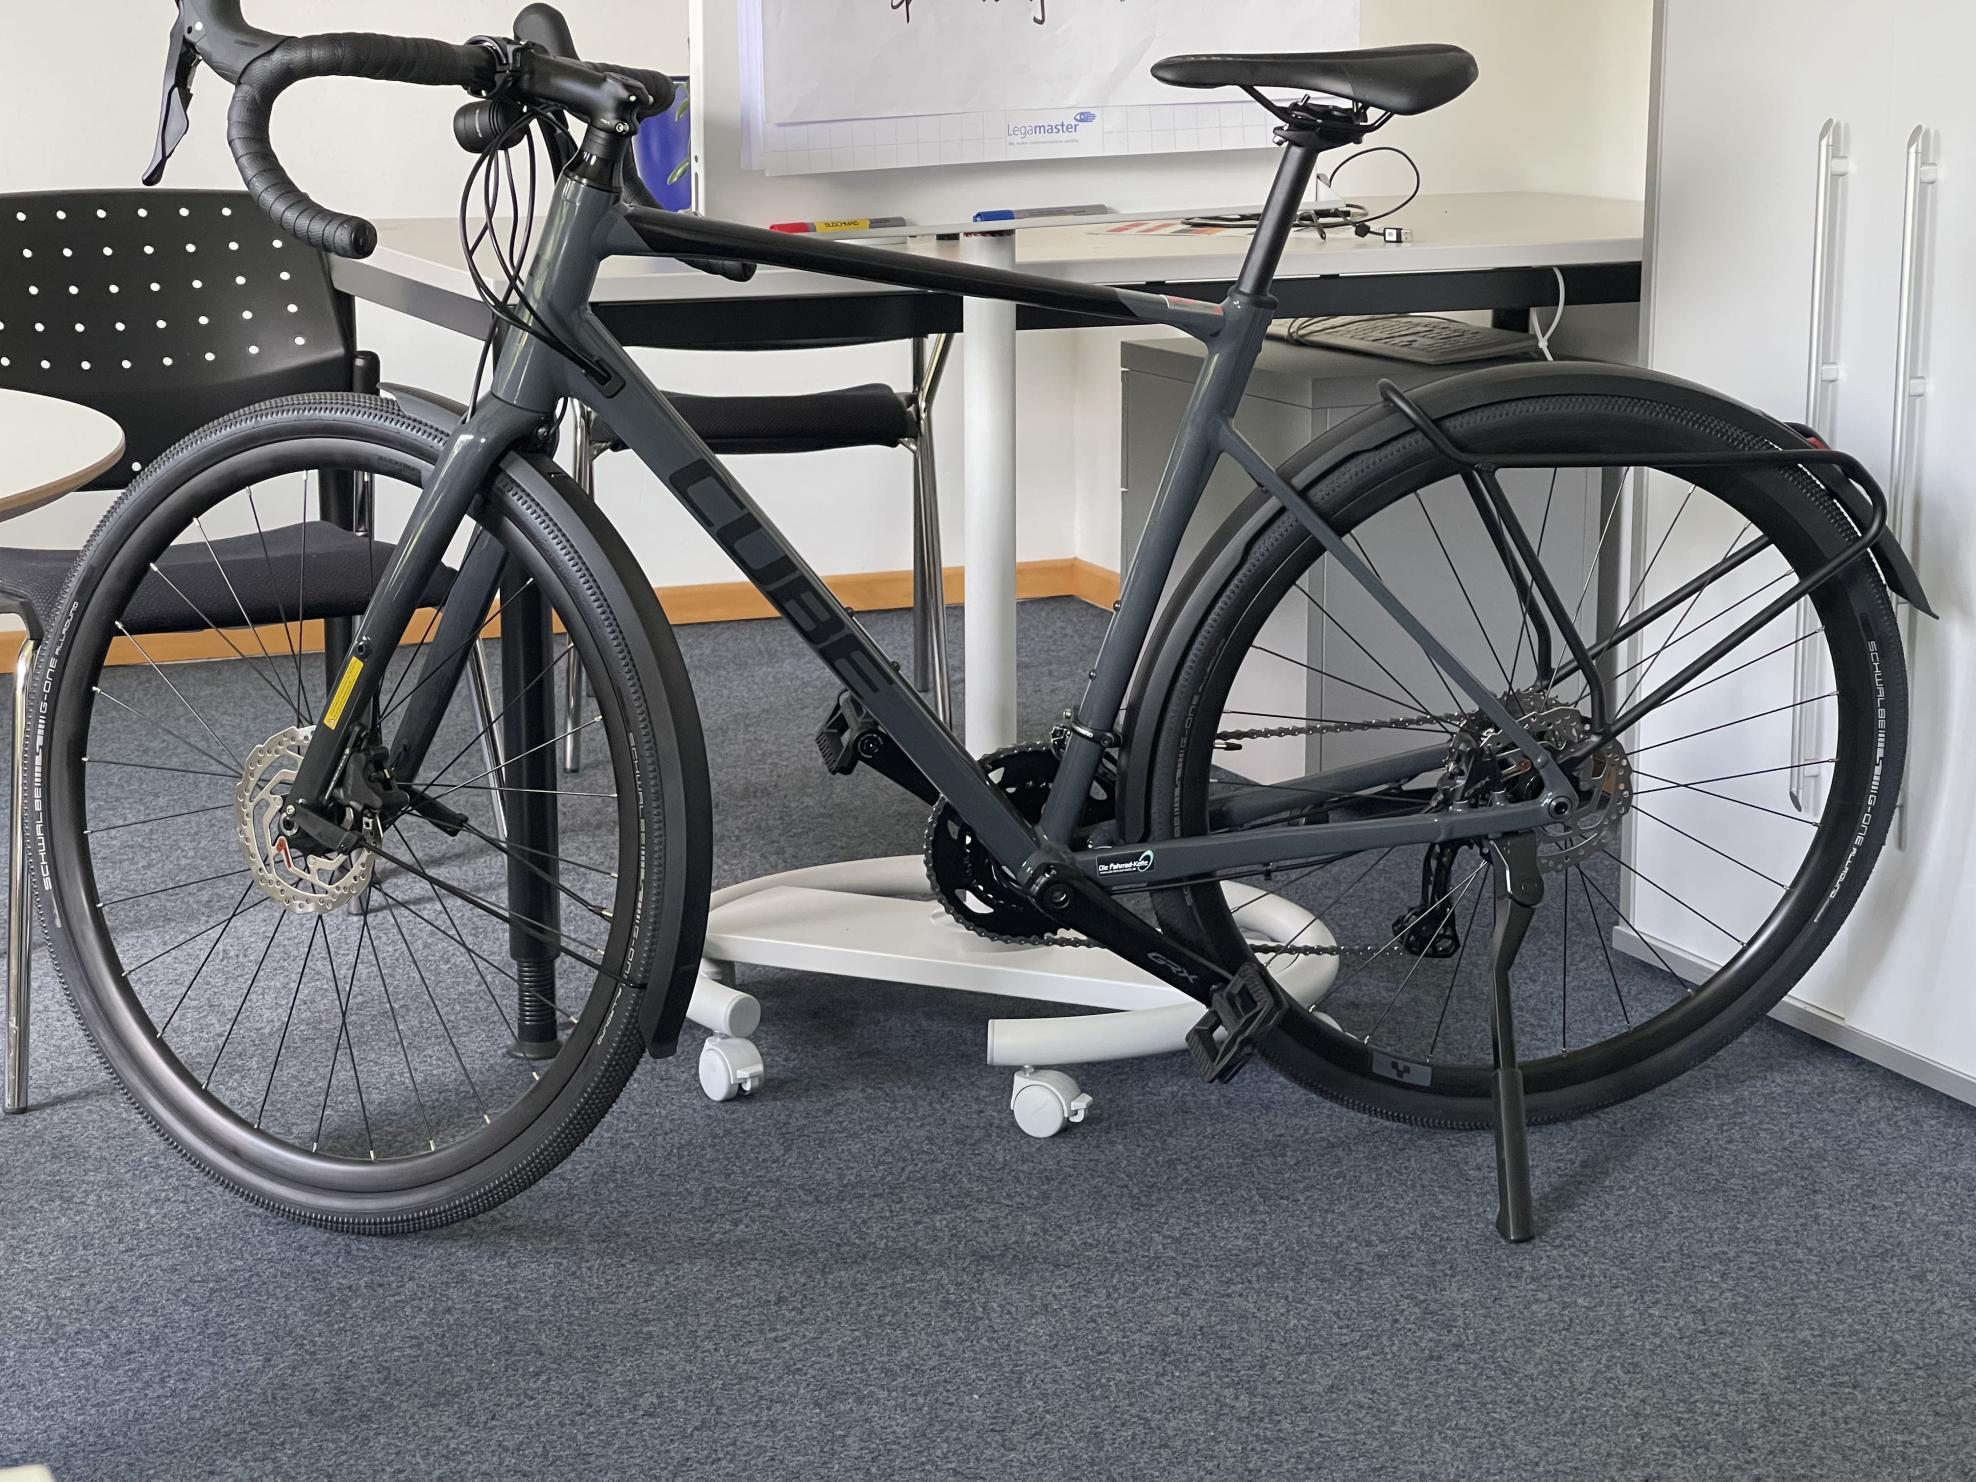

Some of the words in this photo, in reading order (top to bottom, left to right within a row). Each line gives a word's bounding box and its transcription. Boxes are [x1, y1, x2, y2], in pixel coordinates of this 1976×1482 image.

[1007, 121, 1080, 139] Legamaster
[669, 458, 895, 701] CUBE
[55, 601, 79, 656] ALLROUND
[40, 656, 59, 714] G-ONE
[1868, 640, 1886, 729] SCHWALBE
[34, 787, 52, 890] SCHWALBE
[1855, 794, 1877, 846] G-ONE
[1830, 847, 1858, 899] ALLROUND
[1147, 952, 1199, 984] GRX
